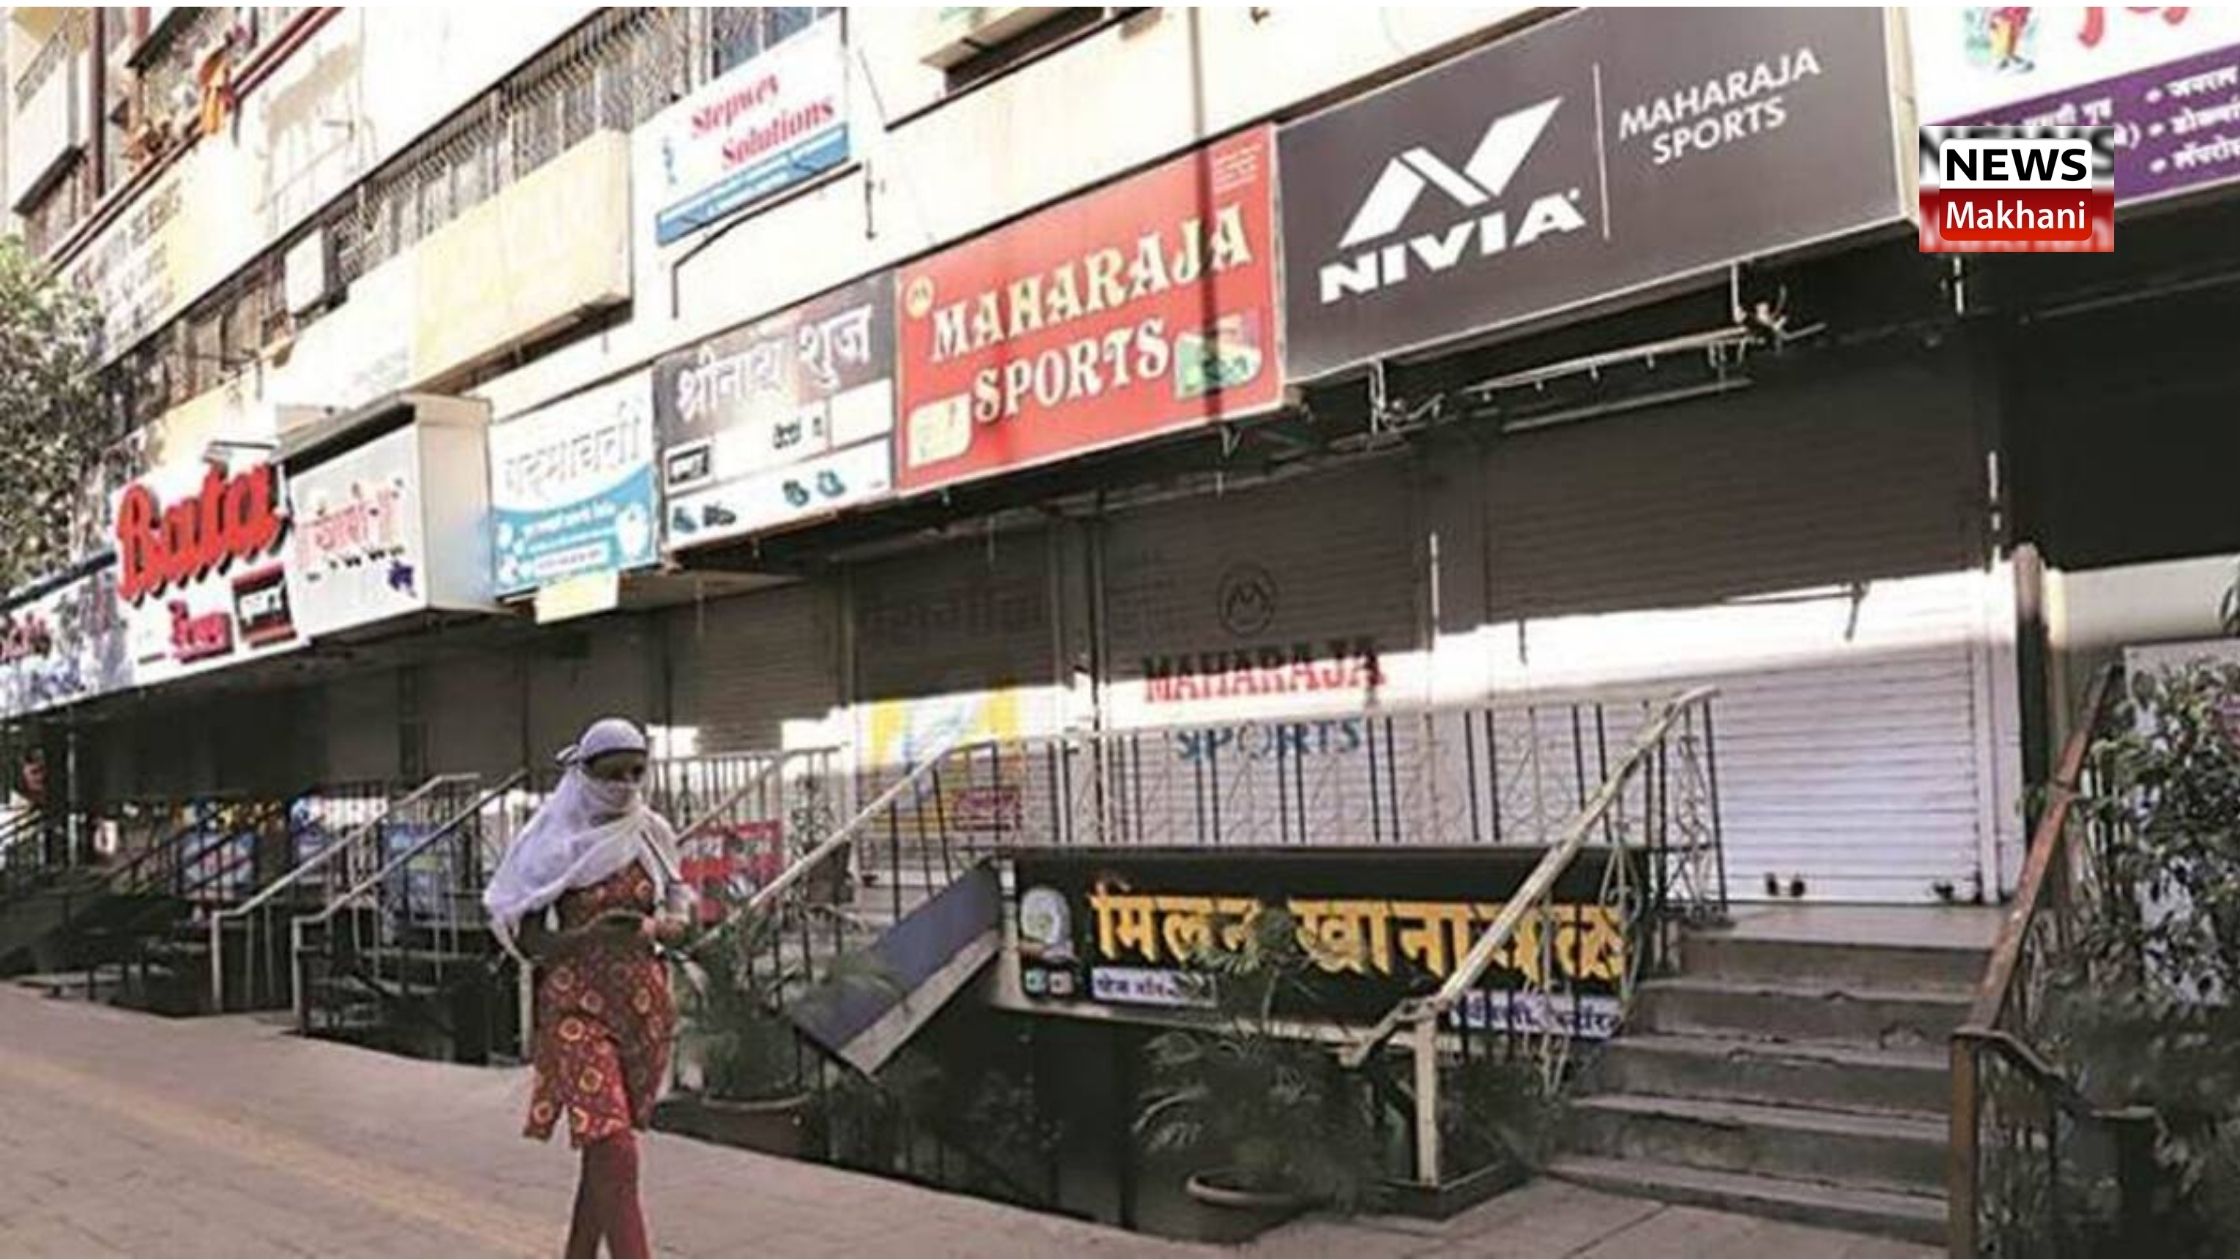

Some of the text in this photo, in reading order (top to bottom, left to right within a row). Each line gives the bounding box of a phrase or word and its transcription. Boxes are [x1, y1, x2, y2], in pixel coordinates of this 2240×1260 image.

[721, 99, 834, 170] Solutions
[1618, 46, 1822, 141] MAHARAJA
[1651, 95, 1788, 166] SPORTS
[931, 203, 1252, 362] MAHARAJA
[1318, 192, 1587, 303] NIVIA
[974, 317, 1170, 424] SPORTS
[117, 462, 282, 604] Bata
[1142, 636, 1384, 703] MAHARAJA
[1177, 716, 1360, 762] SPORTS
